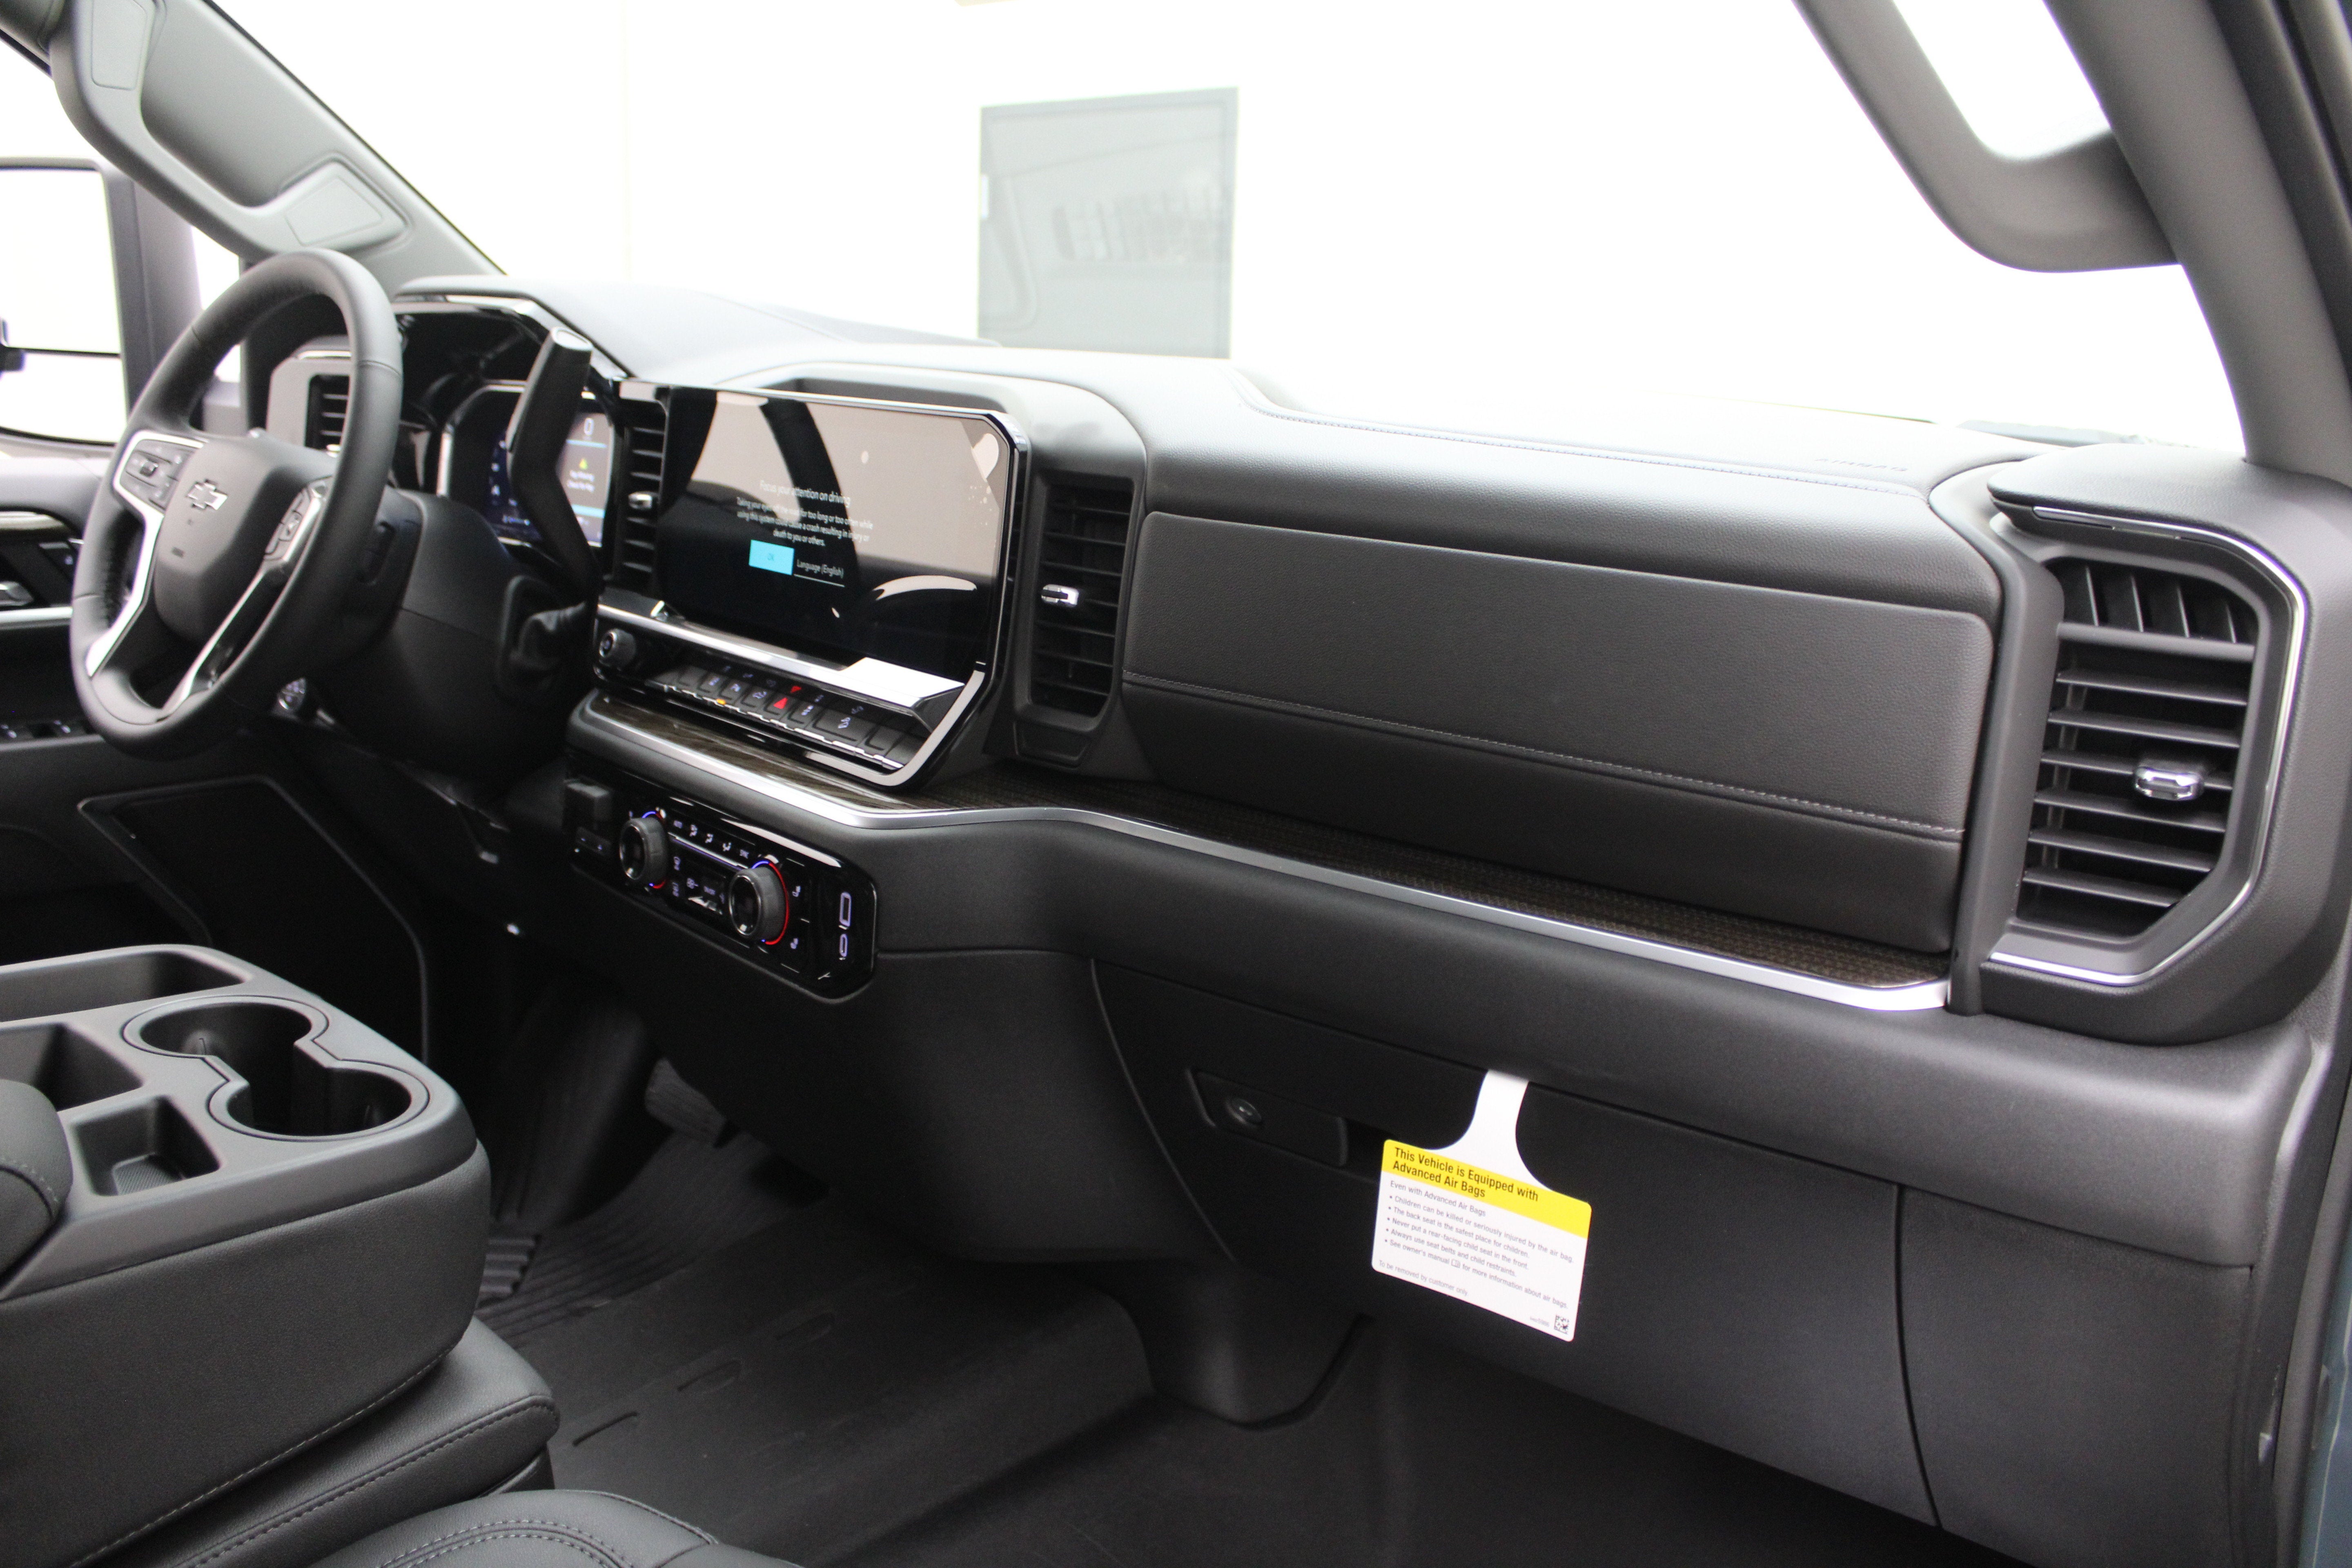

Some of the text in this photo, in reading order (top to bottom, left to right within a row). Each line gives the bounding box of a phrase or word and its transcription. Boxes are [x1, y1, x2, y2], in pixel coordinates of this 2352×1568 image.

[829, 491, 851, 508] driving
[797, 559, 844, 578] Language (English)
[1393, 1160, 1485, 1197] Advanced Air Bags
[1395, 1147, 1538, 1201] This Vehicle is Equipped with
[1390, 1180, 1486, 1216] Even with Advanced Air Bags
[1391, 1229, 1412, 1241] Always
[1427, 1241, 1439, 1250] seat
[1441, 1245, 1456, 1255] belts
[1457, 1252, 1469, 1260] and
[1470, 1256, 1485, 1265] child
[1486, 1262, 1516, 1276] restraints.
[1392, 1218, 1410, 1228] Never
[1428, 1230, 1462, 1247] rear-facing
[1463, 1242, 1478, 1251] child
[1480, 1247, 1493, 1256] seat
[1501, 1254, 1511, 1263] the
[1513, 1258, 1528, 1269] front.
[1394, 1196, 1421, 1209] Children
[1446, 1212, 1463, 1223] killed
[1474, 1222, 1502, 1237] seriously
[1504, 1233, 1526, 1245] injured
[1528, 1240, 1536, 1249] by
[1538, 1244, 1548, 1253] the
[1560, 1252, 1573, 1263] bag.
[1394, 1206, 1405, 1216] The
[1406, 1211, 1421, 1220] back
[1423, 1217, 1436, 1225] seat
[1444, 1223, 1454, 1231] the
[1455, 1227, 1474, 1238] safest
[1475, 1234, 1492, 1244] place
[1503, 1245, 1529, 1257] children.
[1390, 1239, 1401, 1248] See
[1403, 1245, 1426, 1256] owner's
[1428, 1253, 1450, 1264] manual
[1472, 1268, 1487, 1278] more
[1489, 1274, 1523, 1290] information
[1524, 1288, 1541, 1298] about
[1552, 1297, 1568, 1308] bags.
[1395, 1266, 1419, 1279] removed
[1421, 1274, 1428, 1282] by
[1428, 1278, 1454, 1291] customer
